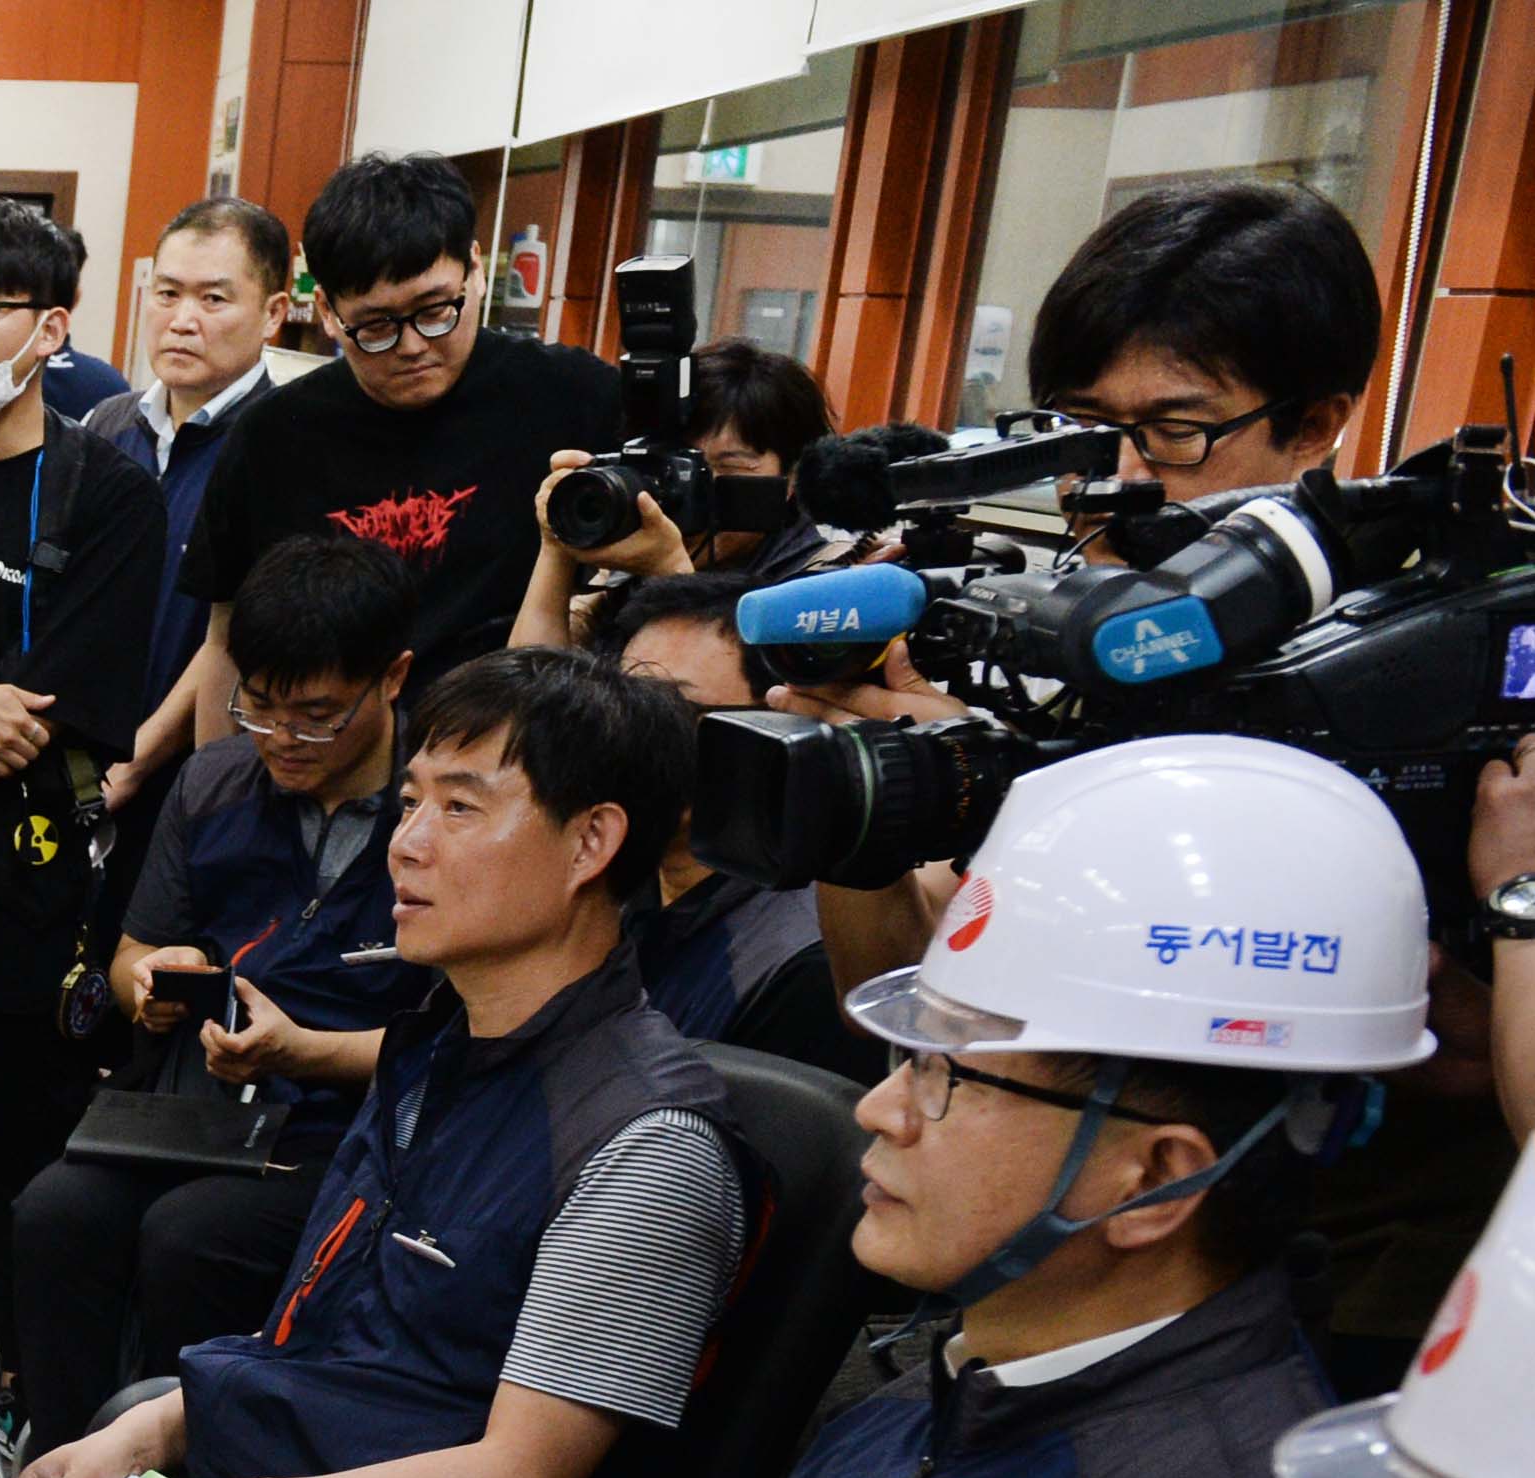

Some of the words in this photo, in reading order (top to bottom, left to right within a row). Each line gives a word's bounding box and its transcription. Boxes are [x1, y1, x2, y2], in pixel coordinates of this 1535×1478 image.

[794, 607, 860, 633] 채널A
[1109, 630, 1200, 663] CHANNEL
[1145, 925, 1342, 974] 동서발전
